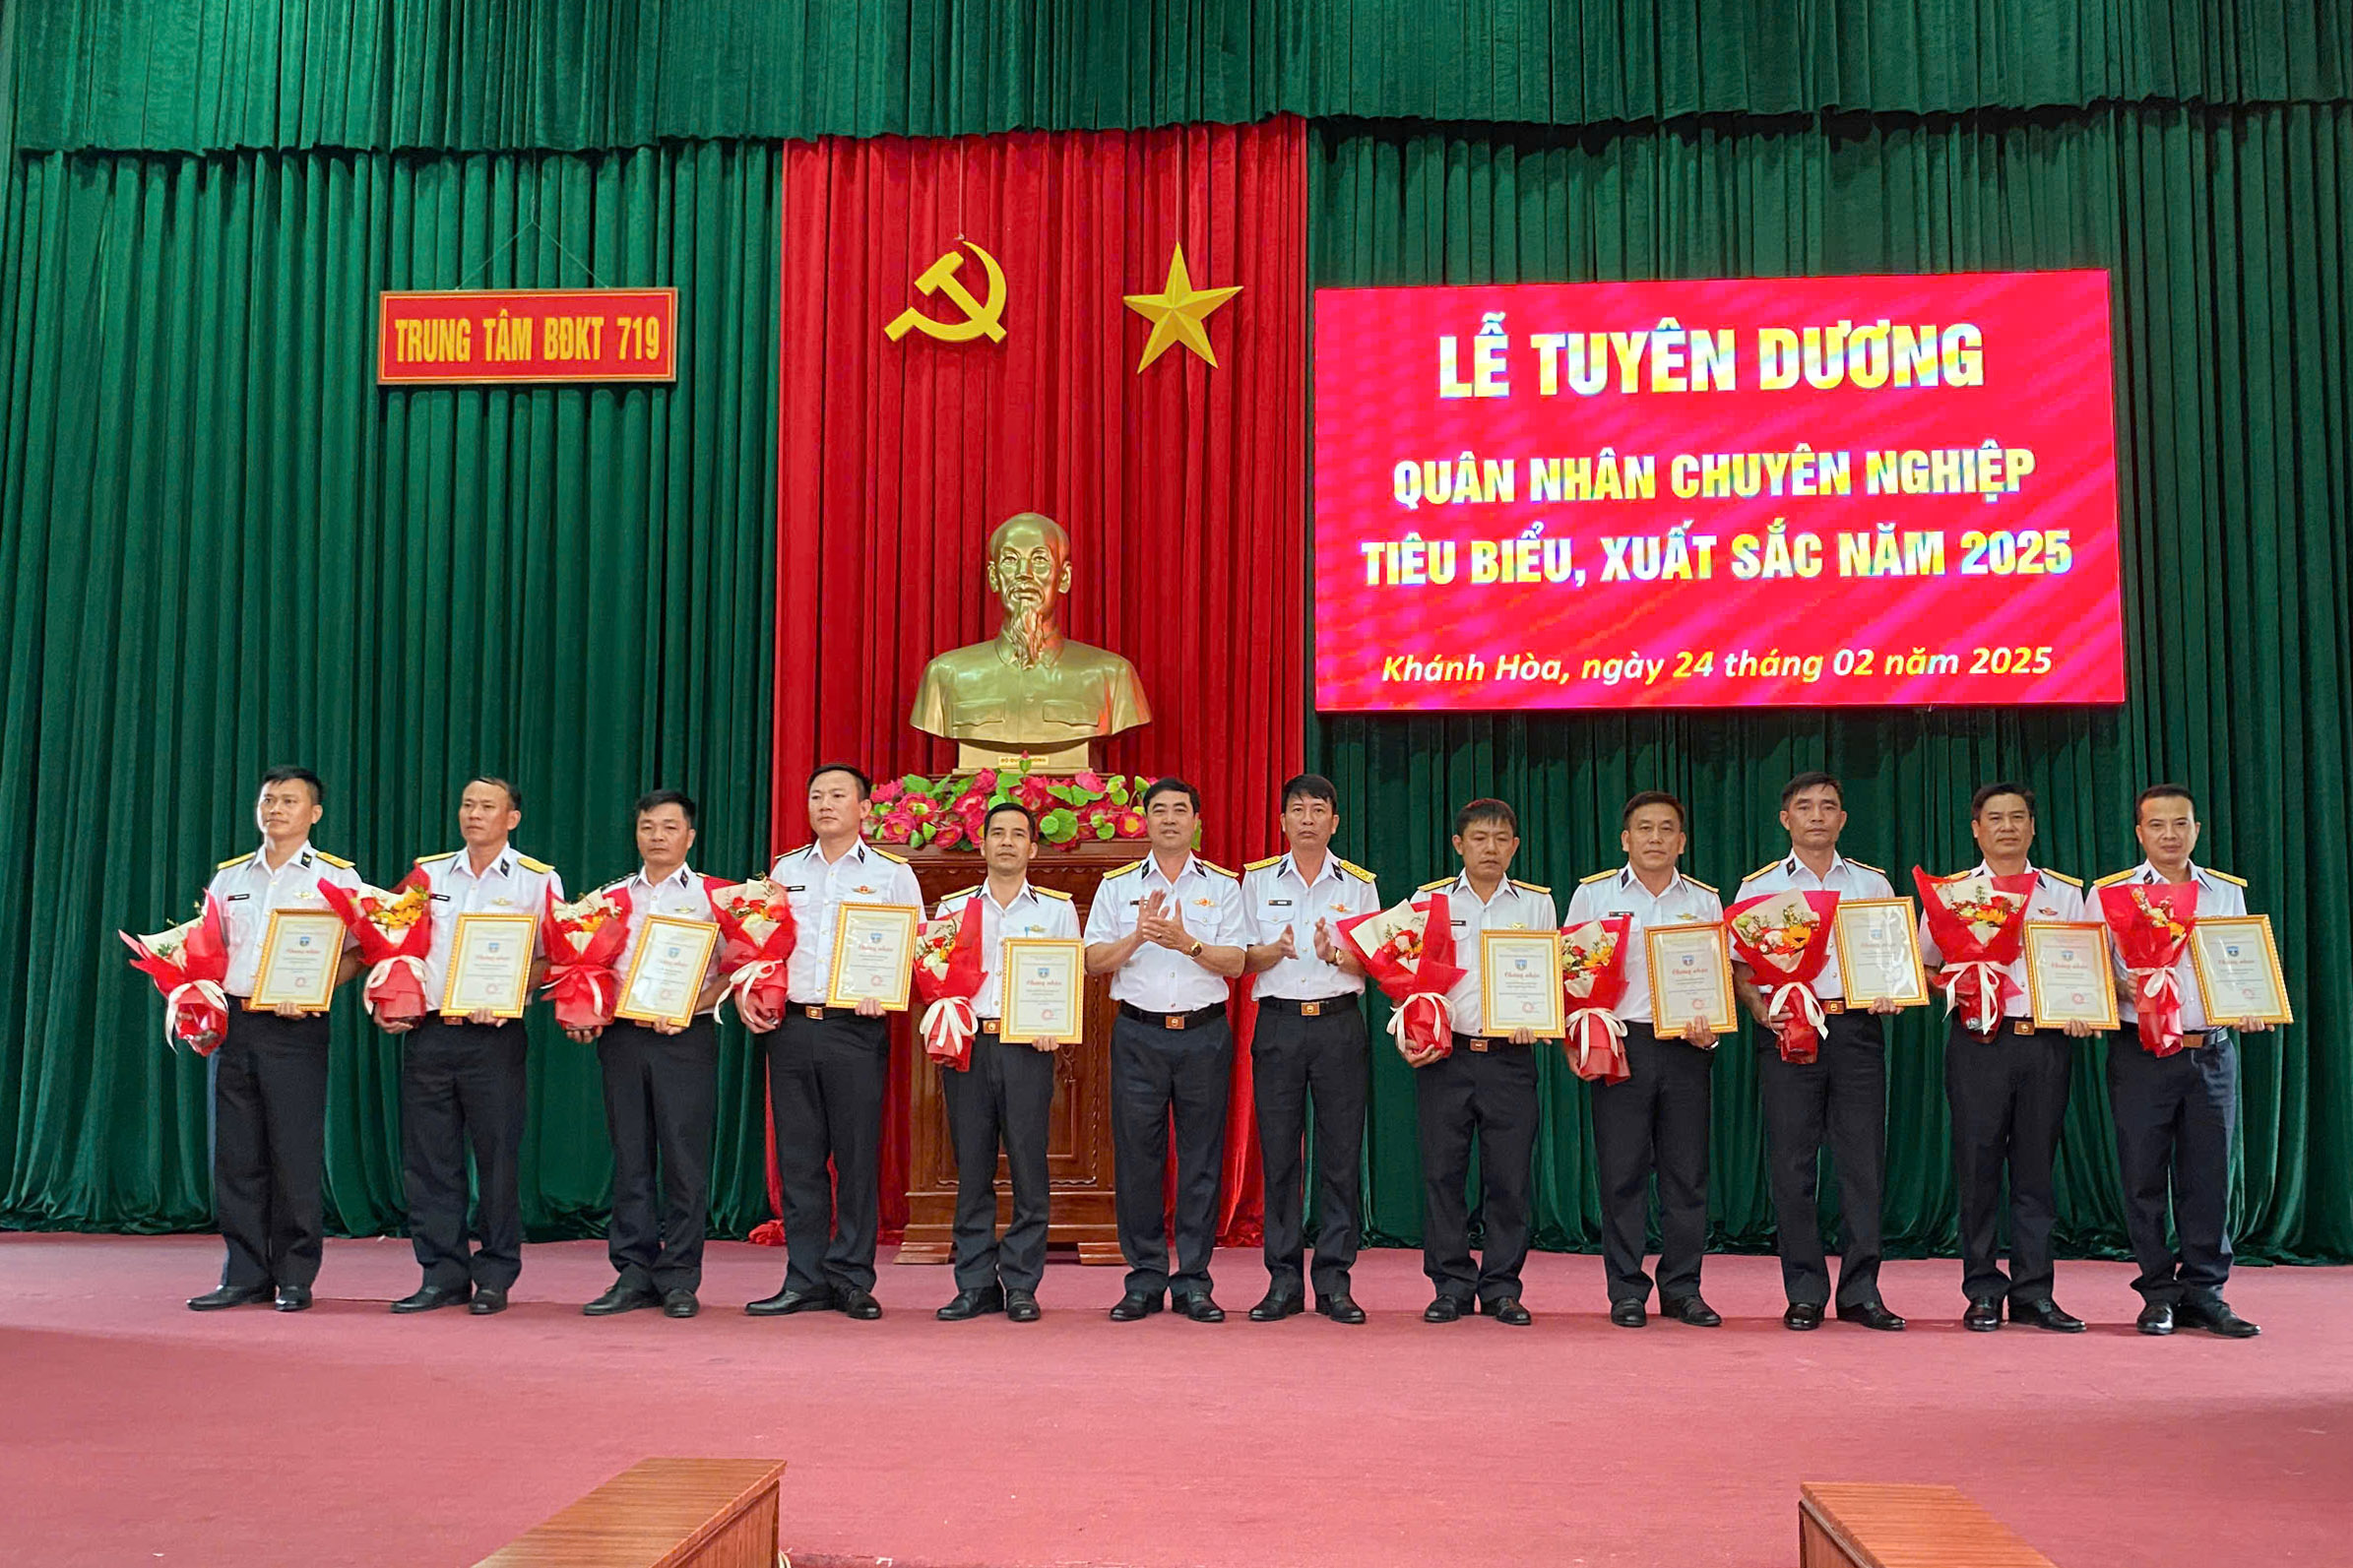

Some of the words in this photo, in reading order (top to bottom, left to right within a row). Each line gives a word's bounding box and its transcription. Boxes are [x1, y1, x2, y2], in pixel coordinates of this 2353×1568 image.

[395, 317, 472, 362] TRUNG
[482, 308, 534, 361] TÂM
[543, 316, 604, 361] BĐKT
[616, 316, 661, 360] 719
[1438, 311, 1510, 399] LỄ
[1530, 316, 1737, 397] TUYÊN
[1758, 319, 1985, 391] DƯƠNG
[1393, 451, 1515, 508] QUÂN
[1529, 447, 1656, 503] NHÂN
[1671, 443, 1852, 499] CHUYÊN
[1866, 439, 2036, 504] NGHIỆP
[1361, 531, 1456, 587] TIÊU
[1470, 521, 1587, 588] BIỂU,
[1600, 519, 1718, 583] XUẤT
[1731, 518, 1823, 581] SẮC
[1837, 523, 1945, 578] NĂM
[1960, 530, 2073, 576] 2025
[1381, 653, 1486, 682] Khánh
[1494, 653, 1570, 685] Hòa,
[1581, 651, 1666, 685] ngày
[1673, 651, 1715, 678] 24
[1725, 649, 1824, 683] tháng
[1833, 649, 1875, 676] 02
[1884, 648, 1960, 676] năm
[1969, 646, 2053, 674] 2025
